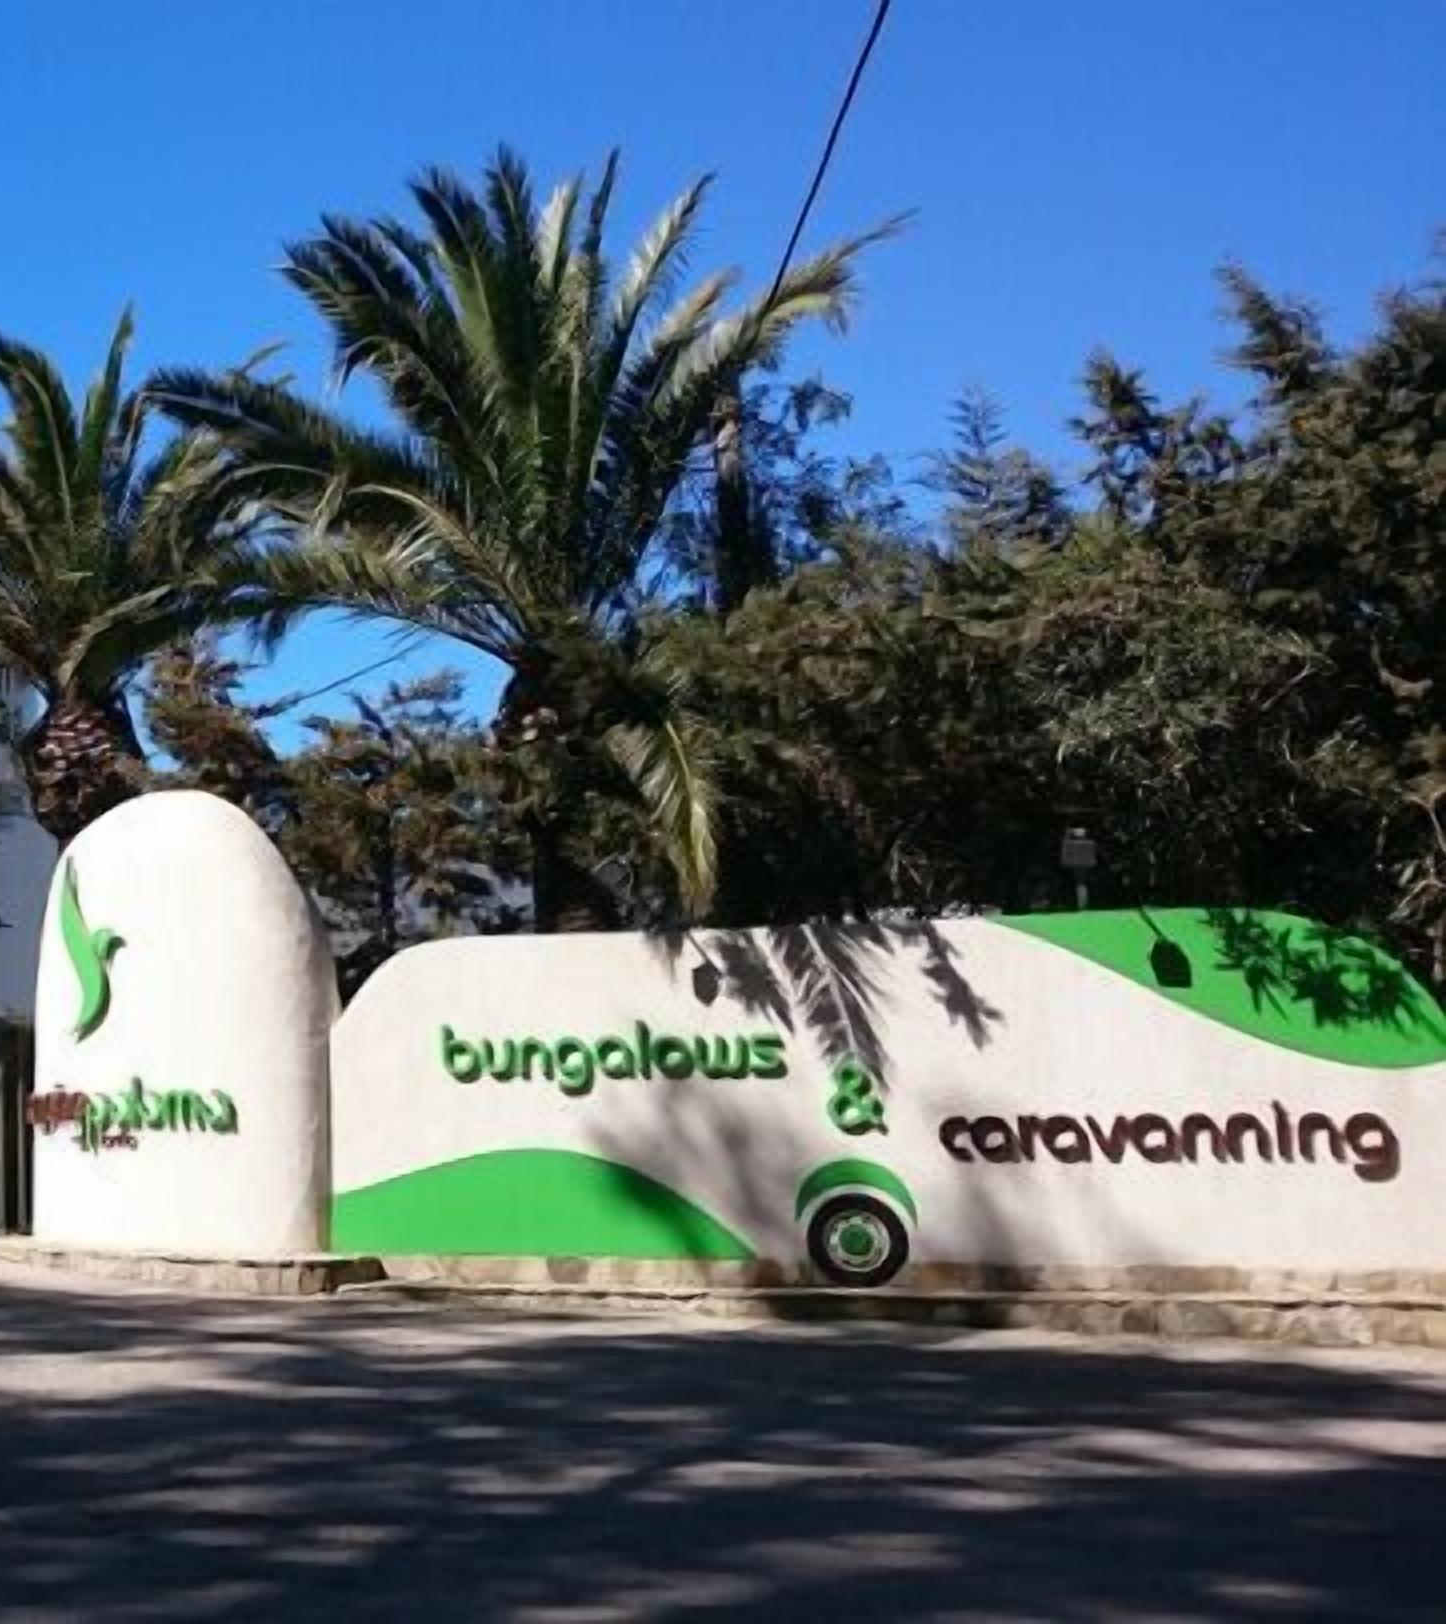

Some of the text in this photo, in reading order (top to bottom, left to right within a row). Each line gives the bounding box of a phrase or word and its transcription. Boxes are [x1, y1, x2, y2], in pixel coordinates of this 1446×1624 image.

[440, 1018, 790, 1097] bungalows
[827, 1055, 890, 1137] &
[938, 1099, 1402, 1183] caravanning
